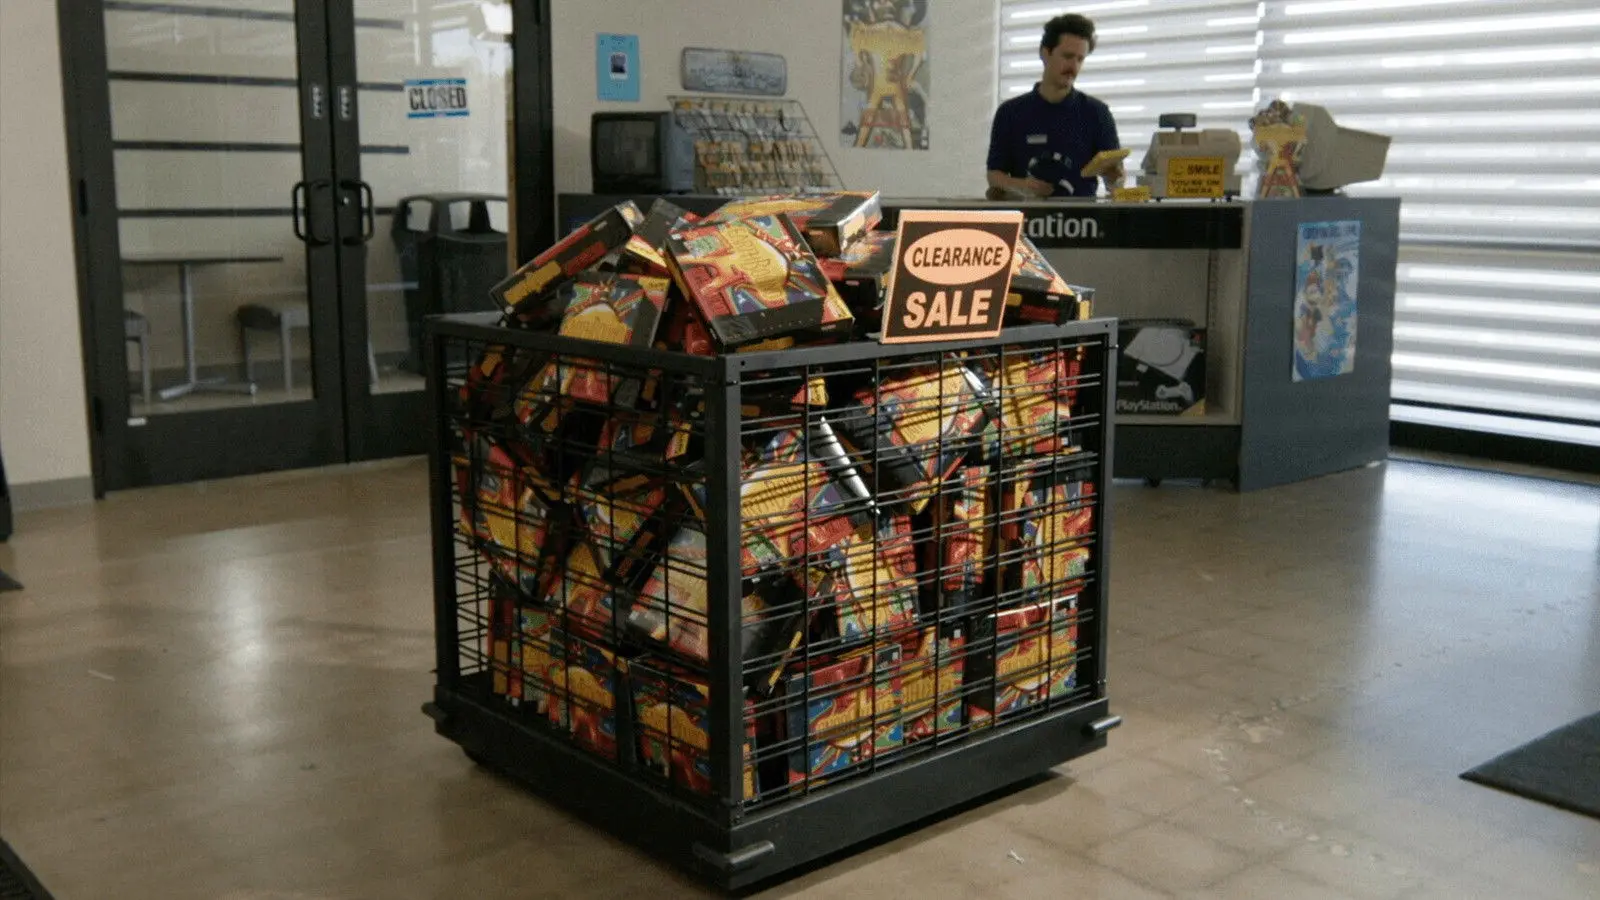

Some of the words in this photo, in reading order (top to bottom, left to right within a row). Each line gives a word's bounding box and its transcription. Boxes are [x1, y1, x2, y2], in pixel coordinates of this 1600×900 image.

[409, 87, 467, 110] CLOSED
[1187, 164, 1220, 175] SMILE
[912, 246, 1004, 268] CLEARANCE
[903, 289, 993, 329] SALE
[1116, 399, 1180, 412] PlayStation
